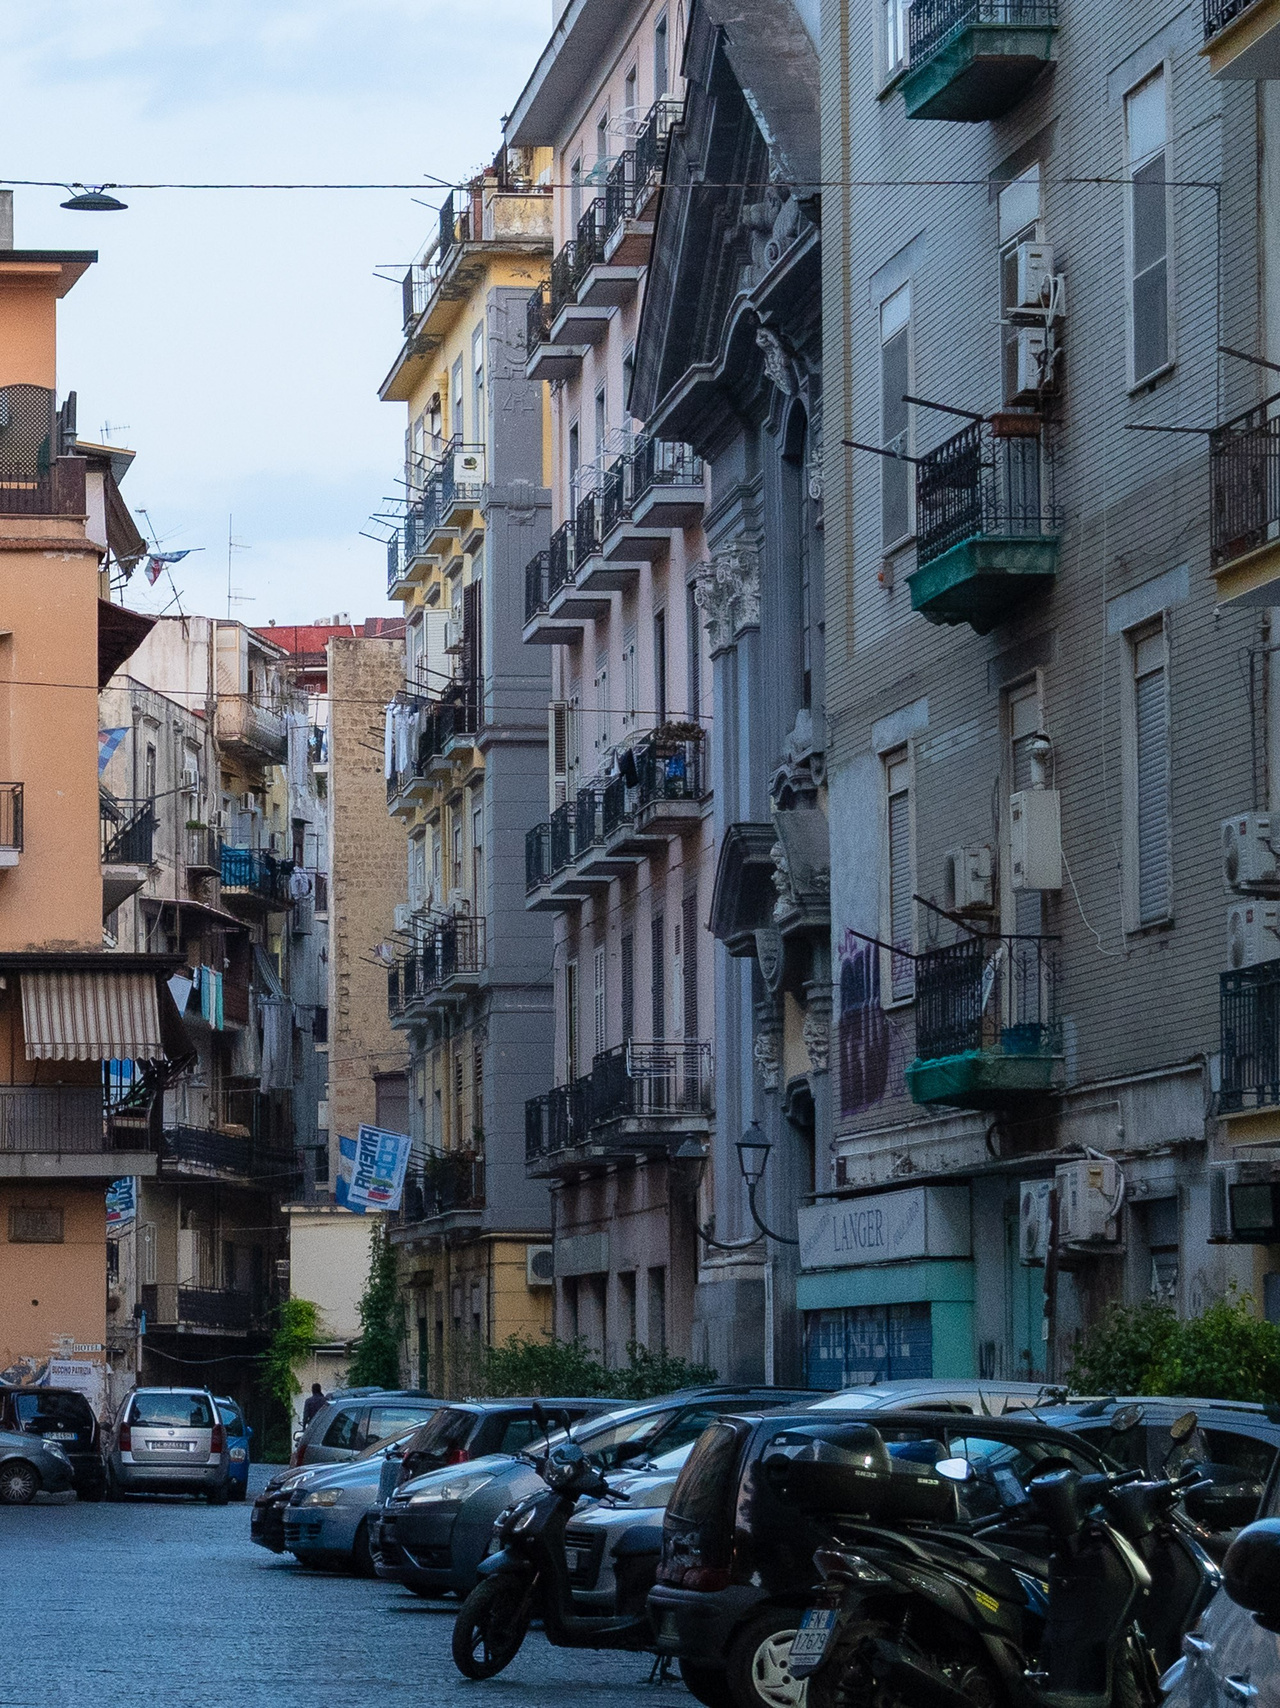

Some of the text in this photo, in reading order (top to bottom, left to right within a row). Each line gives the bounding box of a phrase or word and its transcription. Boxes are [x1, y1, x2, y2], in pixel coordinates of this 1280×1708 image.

[832, 1209, 885, 1252] LANGER
[807, 1611, 824, 1629] FN
[795, 1633, 827, 1650] 17679
